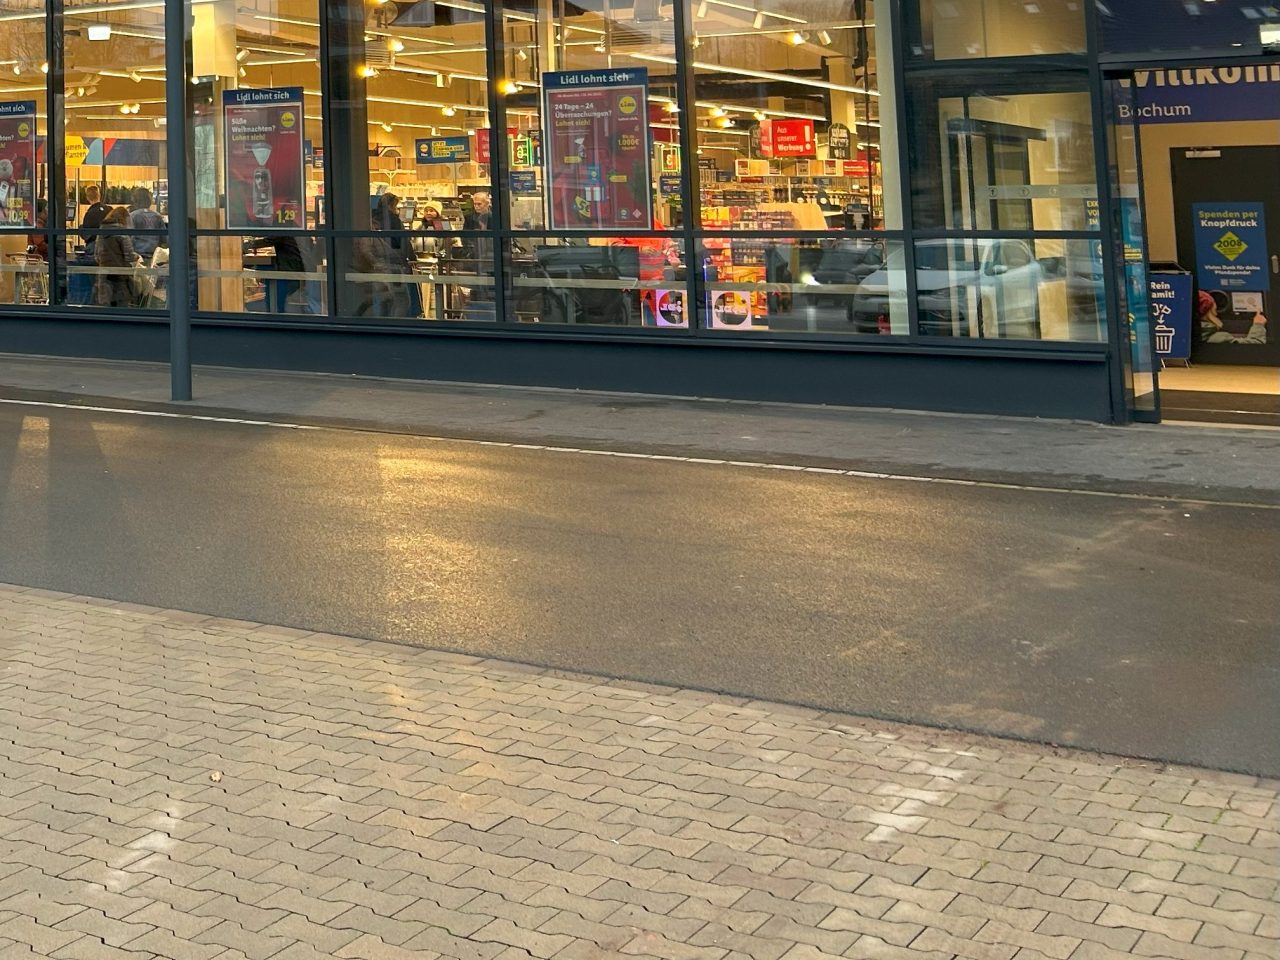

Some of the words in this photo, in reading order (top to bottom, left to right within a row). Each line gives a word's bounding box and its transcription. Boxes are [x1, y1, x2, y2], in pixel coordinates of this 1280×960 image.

[560, 75, 579, 84] Lidl
[580, 74, 607, 84] lohnt
[609, 72, 629, 82] sich
[236, 93, 251, 101] Lidl
[251, 92, 272, 100] lohnt
[273, 91, 290, 99] sich
[12, 104, 25, 112] sich
[564, 103, 579, 111] Tage
[1118, 102, 1191, 118] Bochum
[554, 110, 612, 119] Überraschungen?
[231, 125, 276, 133] Weihnachten?
[1198, 210, 1241, 219] Spenden
[1241, 211, 1258, 219] per
[1201, 219, 1258, 228] Knopfdruck
[1150, 281, 1170, 290] Rein
[1151, 290, 1175, 299] amit!
